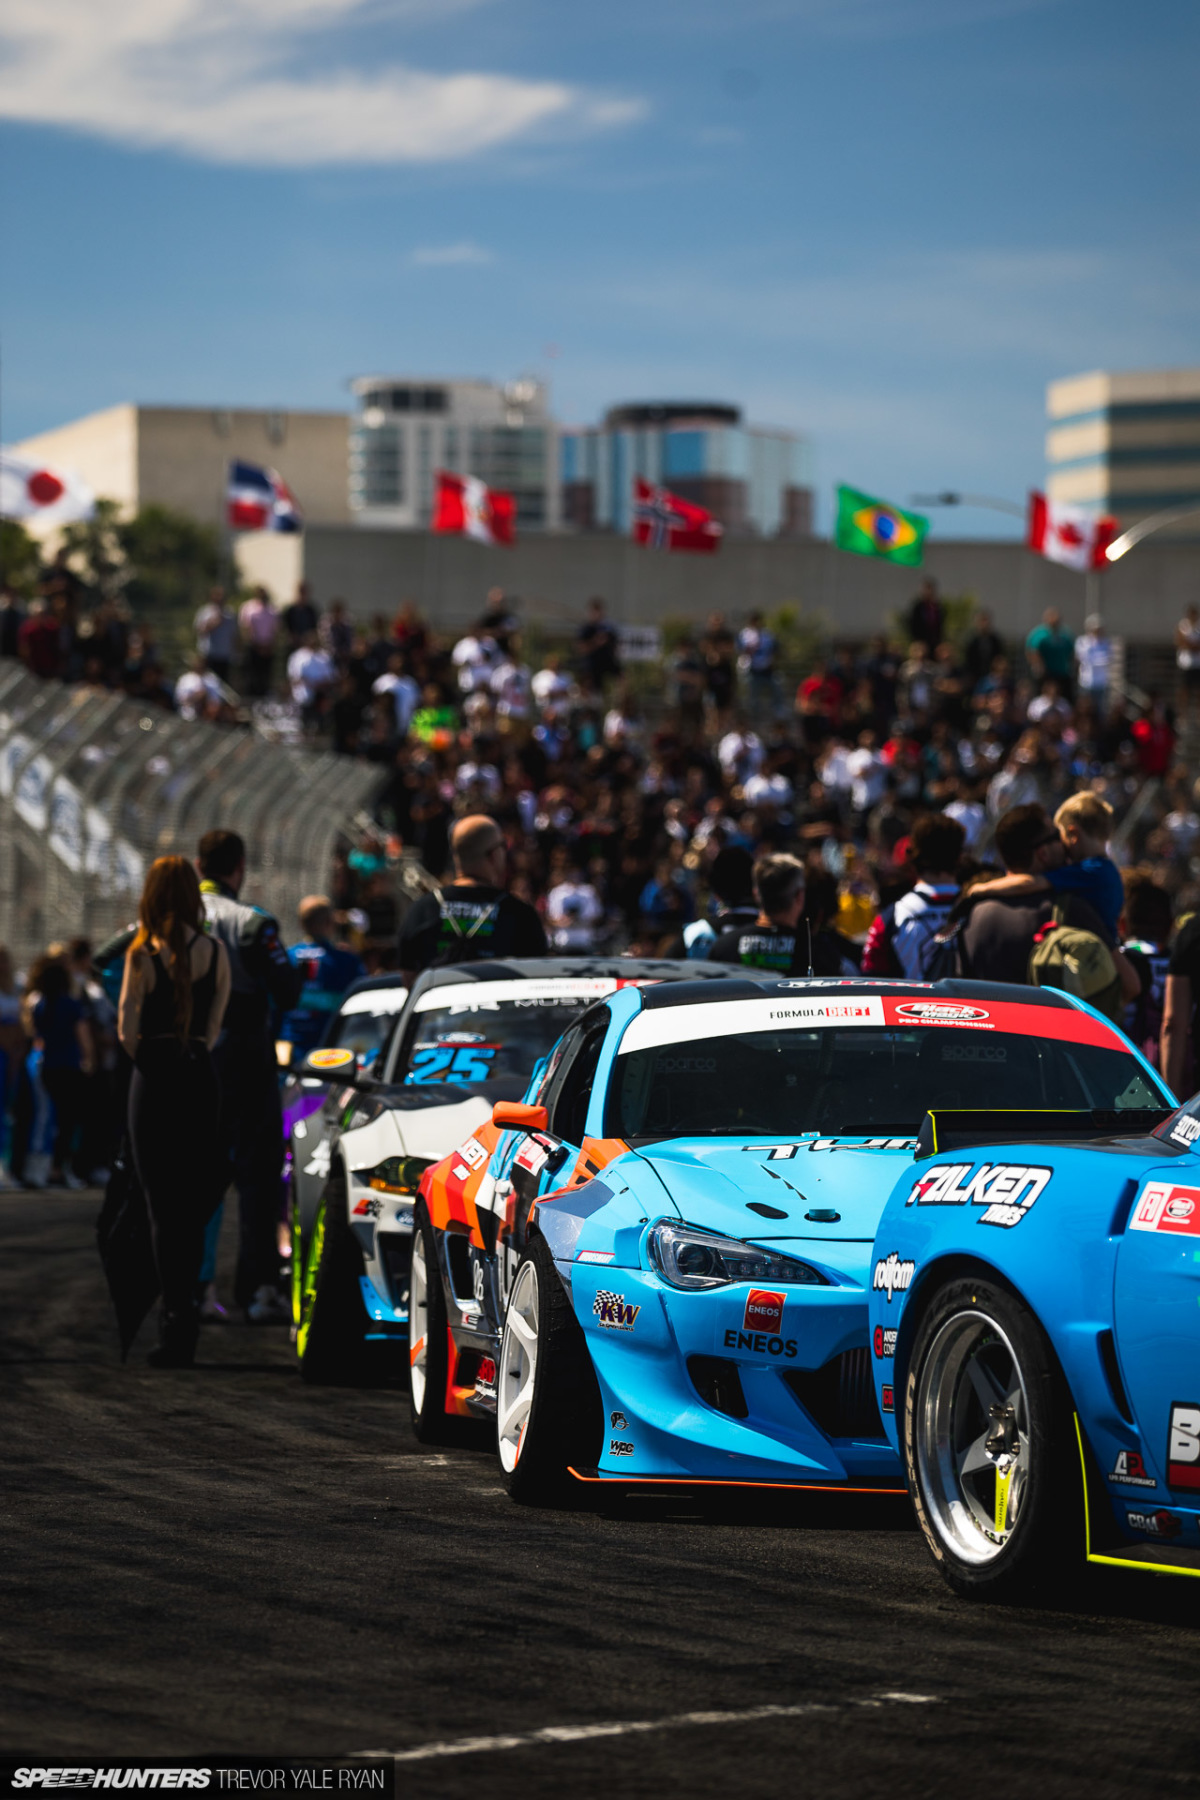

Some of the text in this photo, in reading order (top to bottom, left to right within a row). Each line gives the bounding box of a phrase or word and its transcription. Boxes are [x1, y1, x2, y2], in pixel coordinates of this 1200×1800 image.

[770, 1007, 870, 1019] FORMULA DRIFT
[920, 1019, 995, 1029] CHAMPIONSHIP
[405, 1047, 495, 1085] 25
[905, 1162, 1053, 1207] FALKEN
[600, 1301, 642, 1326] KW
[748, 1305, 780, 1317] ENEOS
[724, 1329, 798, 1358] ENEOS
